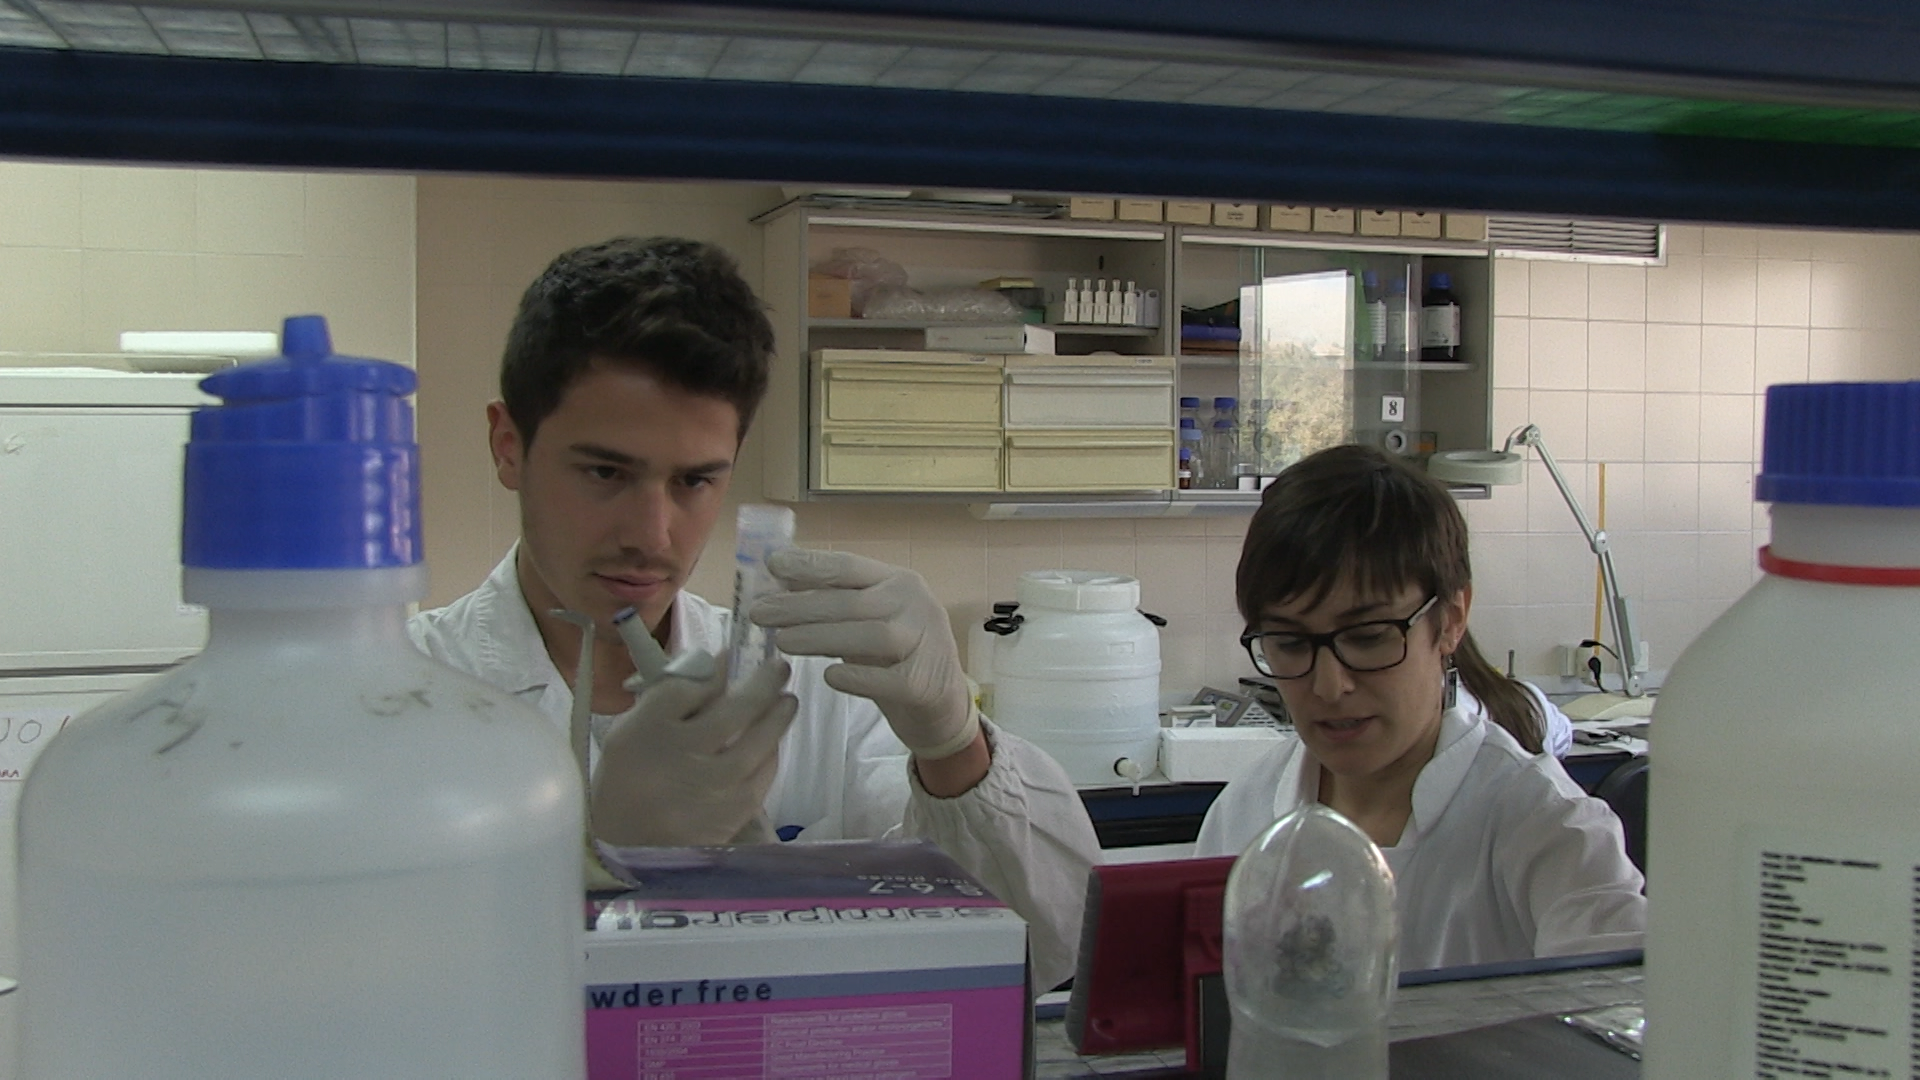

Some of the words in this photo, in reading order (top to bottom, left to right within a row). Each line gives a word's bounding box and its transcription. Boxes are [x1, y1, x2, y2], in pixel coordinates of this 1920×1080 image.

[1388, 399, 1398, 416] 8
[868, 877, 935, 895] 6-7
[591, 983, 683, 1008] wder
[697, 979, 772, 1003] free
